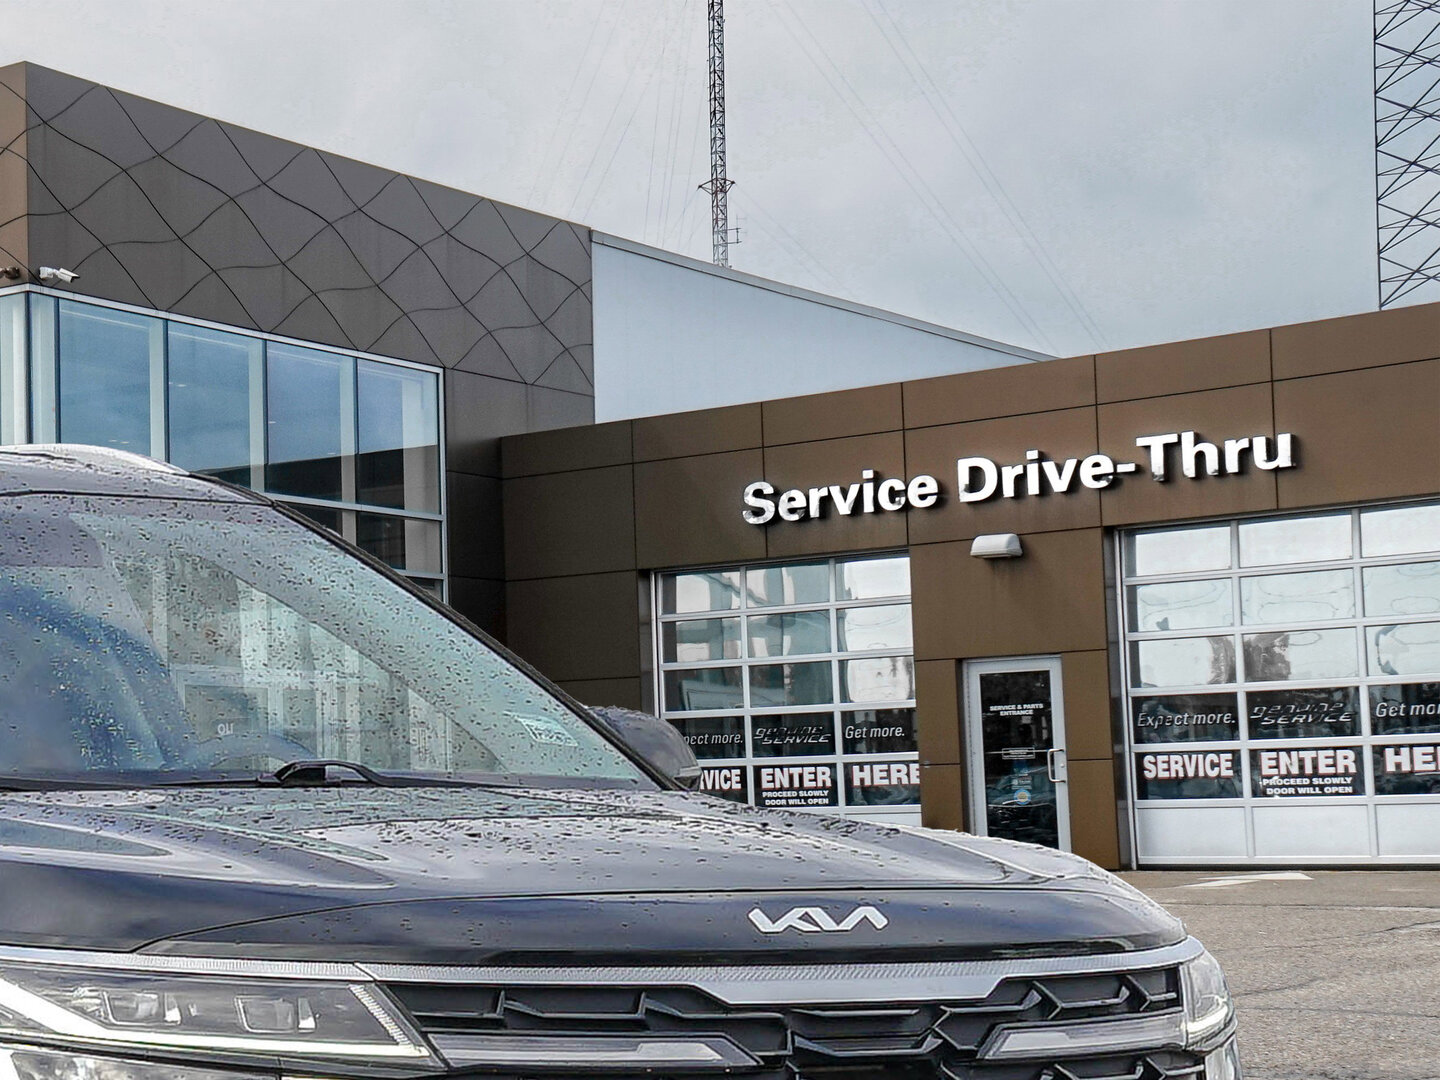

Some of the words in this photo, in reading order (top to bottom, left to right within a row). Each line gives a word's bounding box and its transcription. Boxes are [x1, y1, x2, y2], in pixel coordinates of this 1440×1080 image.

[741, 470, 938, 525] Service
[957, 430, 1295, 504] Drive-Thru
[1375, 702, 1406, 718] Get
[1137, 712, 1190, 729] Expect
[1192, 712, 1236, 725] more.
[1261, 712, 1352, 725] SERVICE
[711, 733, 743, 744] more.
[845, 725, 867, 739] Get
[869, 726, 905, 738] more.
[762, 734, 831, 745] SERVICE
[1143, 753, 1234, 779] SERVICE
[1260, 749, 1357, 776] ENTER
[1384, 746, 1440, 773] HE
[760, 766, 832, 789] ENTER
[852, 763, 920, 787] HERE
[1262, 778, 1310, 786] PROCEED
[1312, 776, 1353, 785] SLOWLY
[1266, 787, 1296, 795] DOOR
[1297, 786, 1322, 794] WILL
